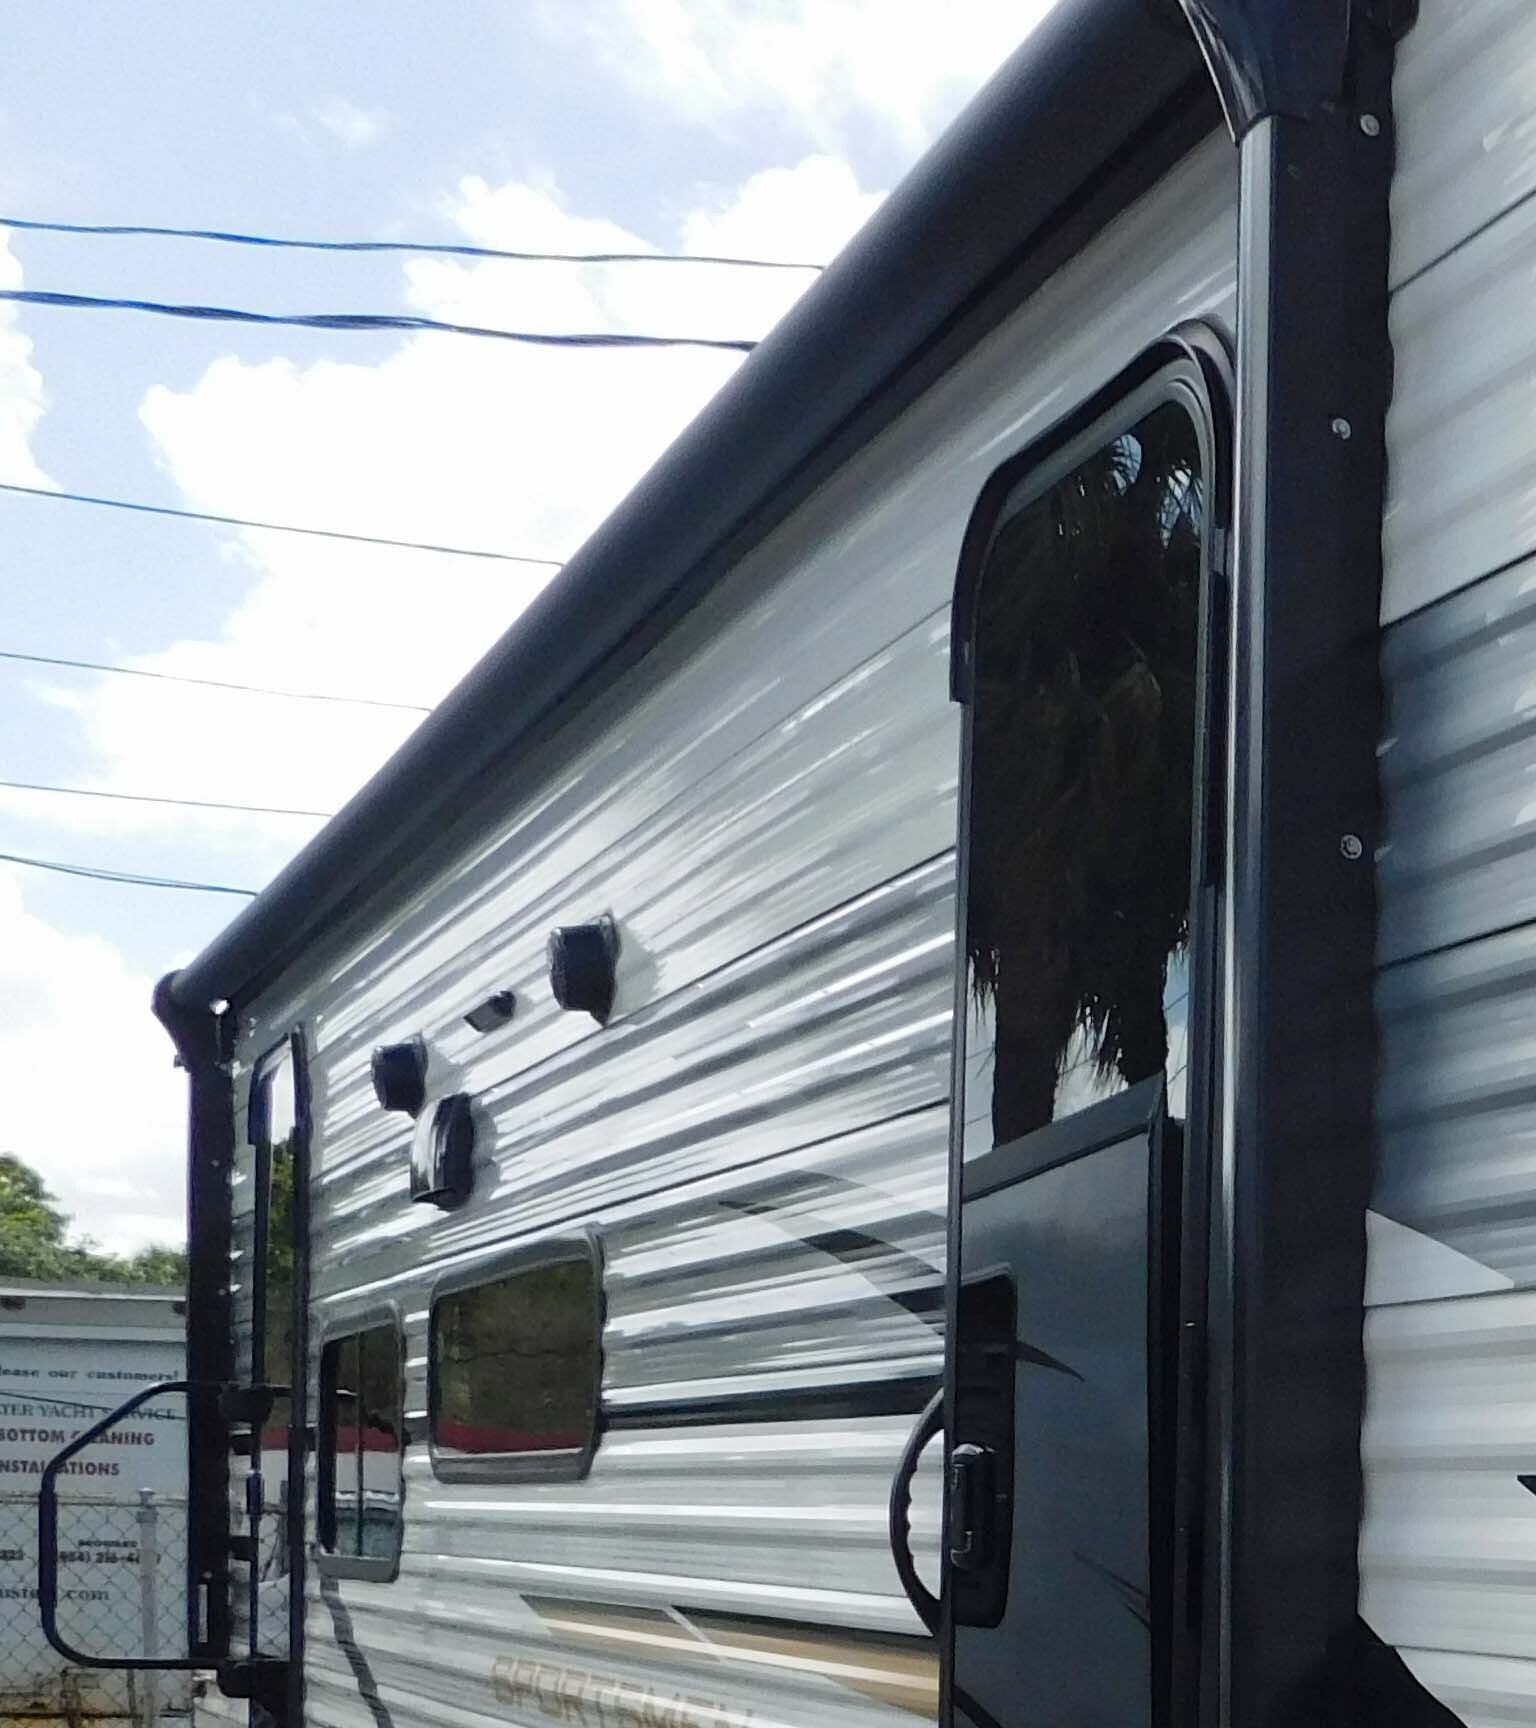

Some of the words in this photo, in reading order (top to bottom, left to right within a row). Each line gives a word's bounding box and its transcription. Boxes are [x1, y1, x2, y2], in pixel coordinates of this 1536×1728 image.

[48, 1368, 78, 1379] our
[87, 1369, 180, 1381] customers!
[39, 1402, 96, 1420] YACHT
[100, 1406, 178, 1420] SRVICE
